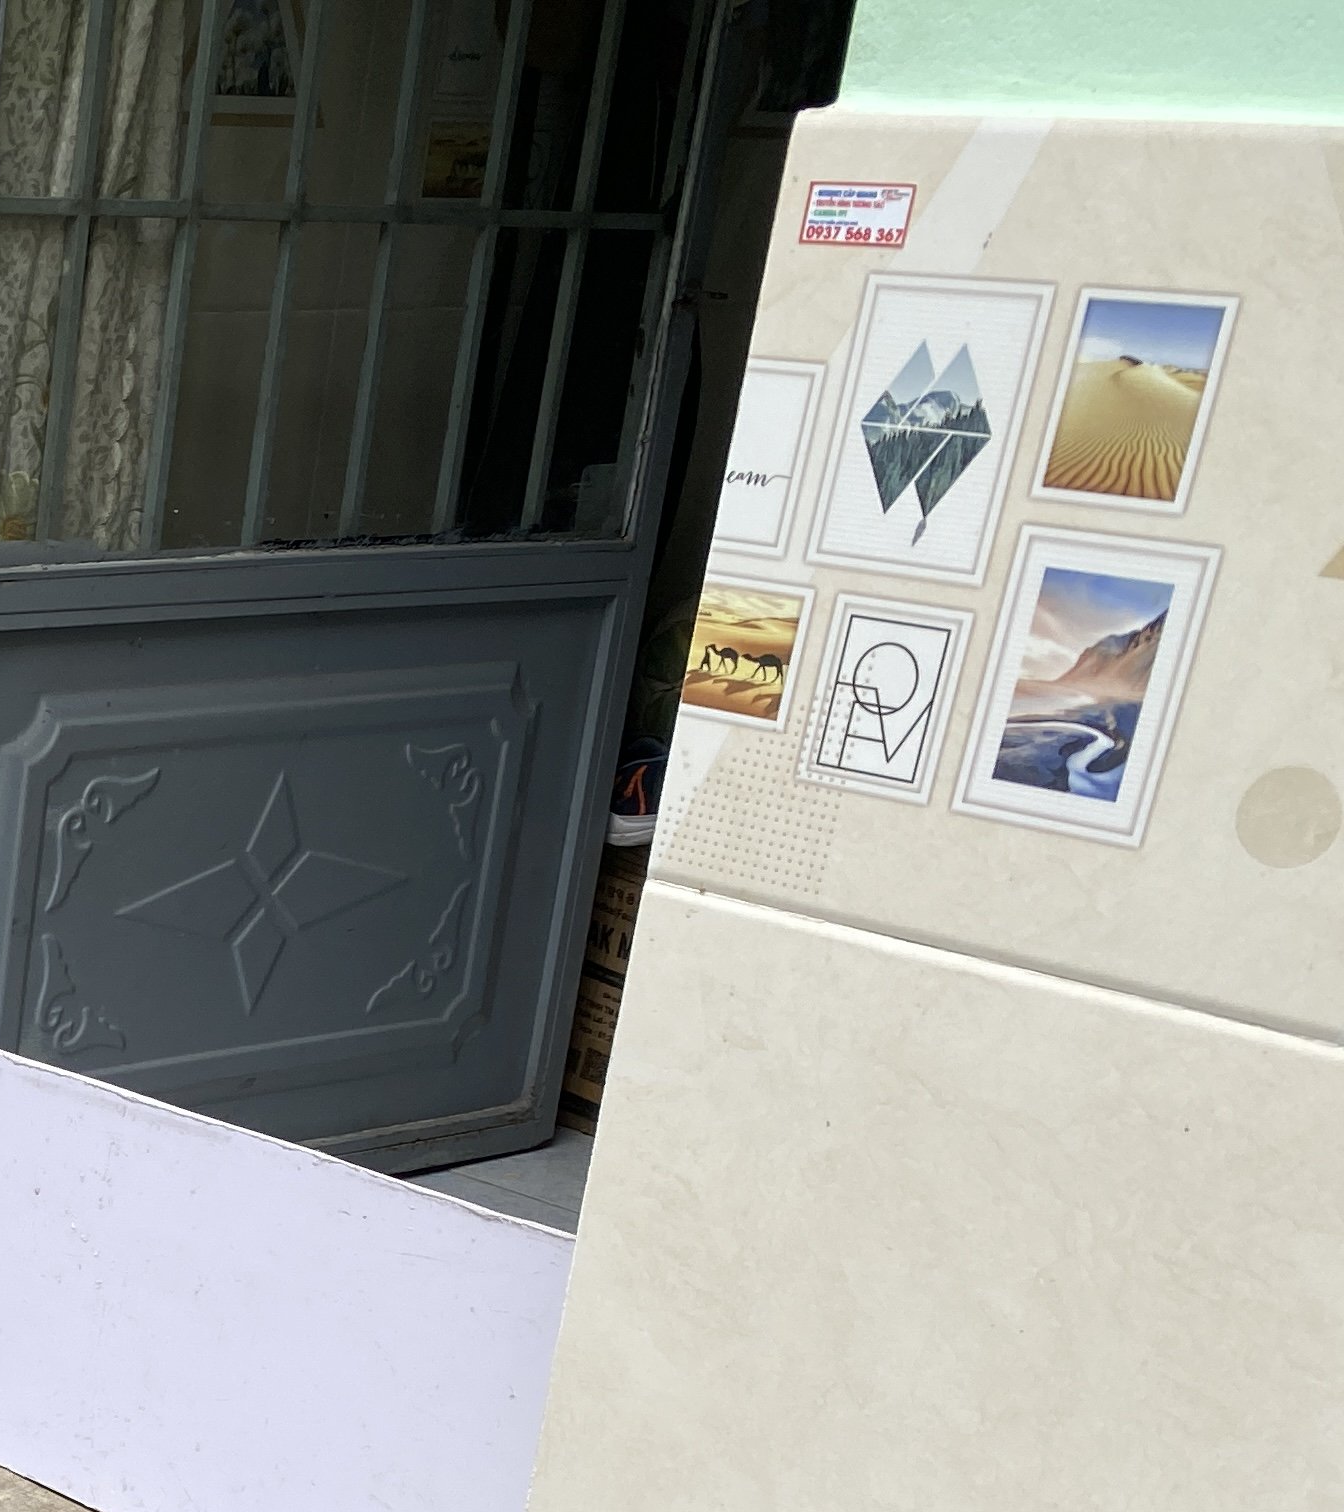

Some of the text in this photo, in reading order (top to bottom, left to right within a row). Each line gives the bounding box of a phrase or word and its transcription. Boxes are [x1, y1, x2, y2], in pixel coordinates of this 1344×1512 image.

[806, 225, 904, 243] 0937 568 367
